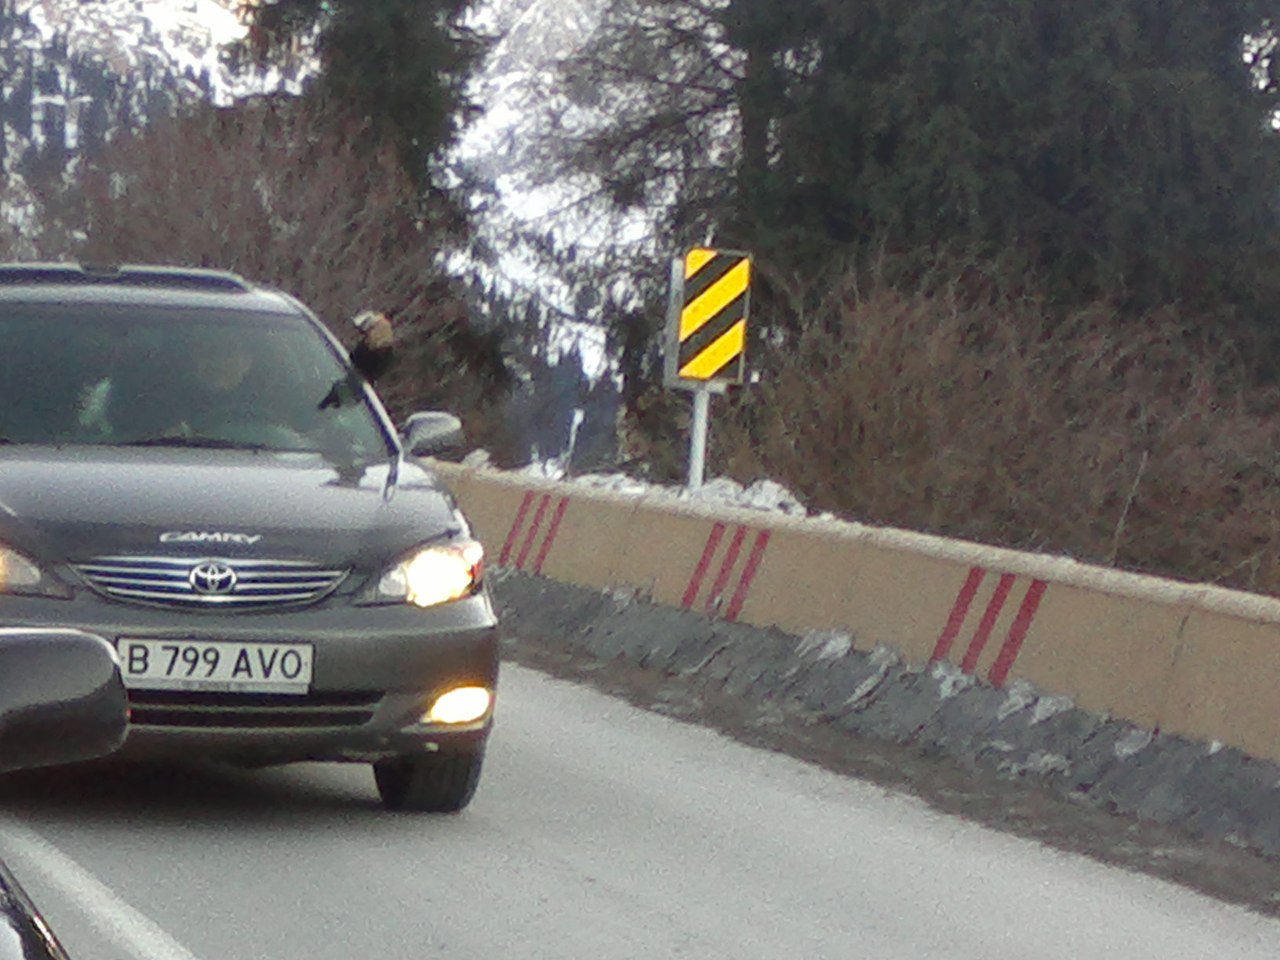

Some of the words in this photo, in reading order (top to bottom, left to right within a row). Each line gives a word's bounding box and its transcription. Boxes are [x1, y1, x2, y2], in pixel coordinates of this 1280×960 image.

[158, 530, 262, 545] CAMRY
[127, 644, 150, 675] B
[161, 645, 220, 677] 799
[231, 647, 302, 679] AVO
